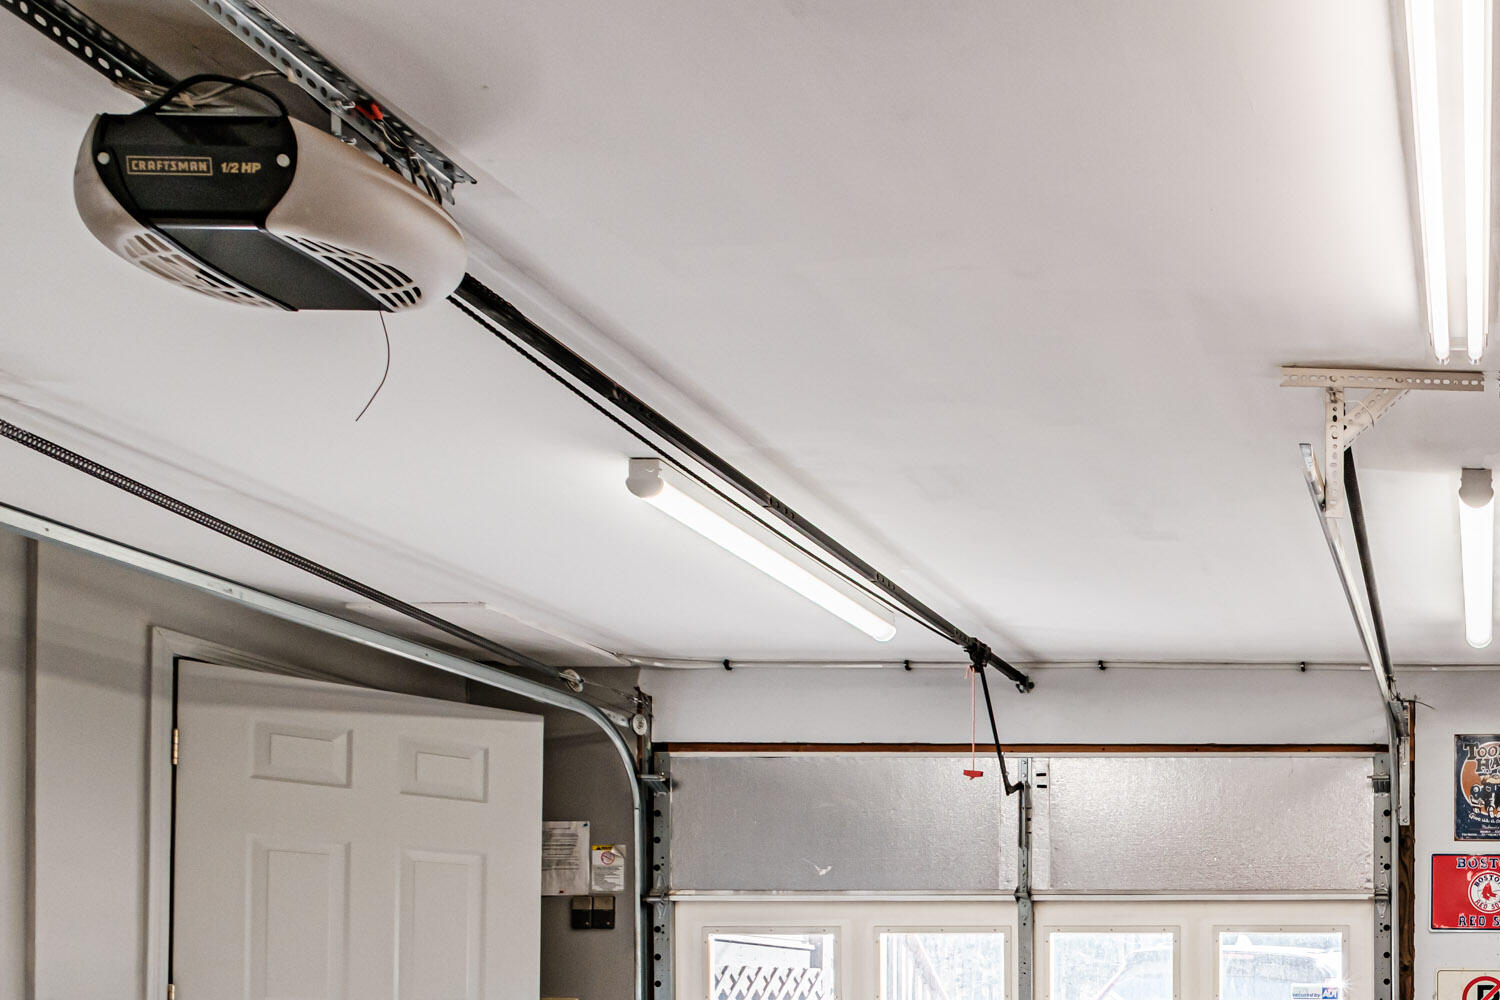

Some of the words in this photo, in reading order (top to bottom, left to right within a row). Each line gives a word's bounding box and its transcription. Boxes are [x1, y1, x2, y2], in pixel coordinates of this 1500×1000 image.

[131, 160, 207, 172] CRAFTSMAN
[221, 162, 239, 173] 1/2
[241, 162, 262, 174] HP
[1475, 899, 1489, 910] RED
[1458, 914, 1487, 927] RED
